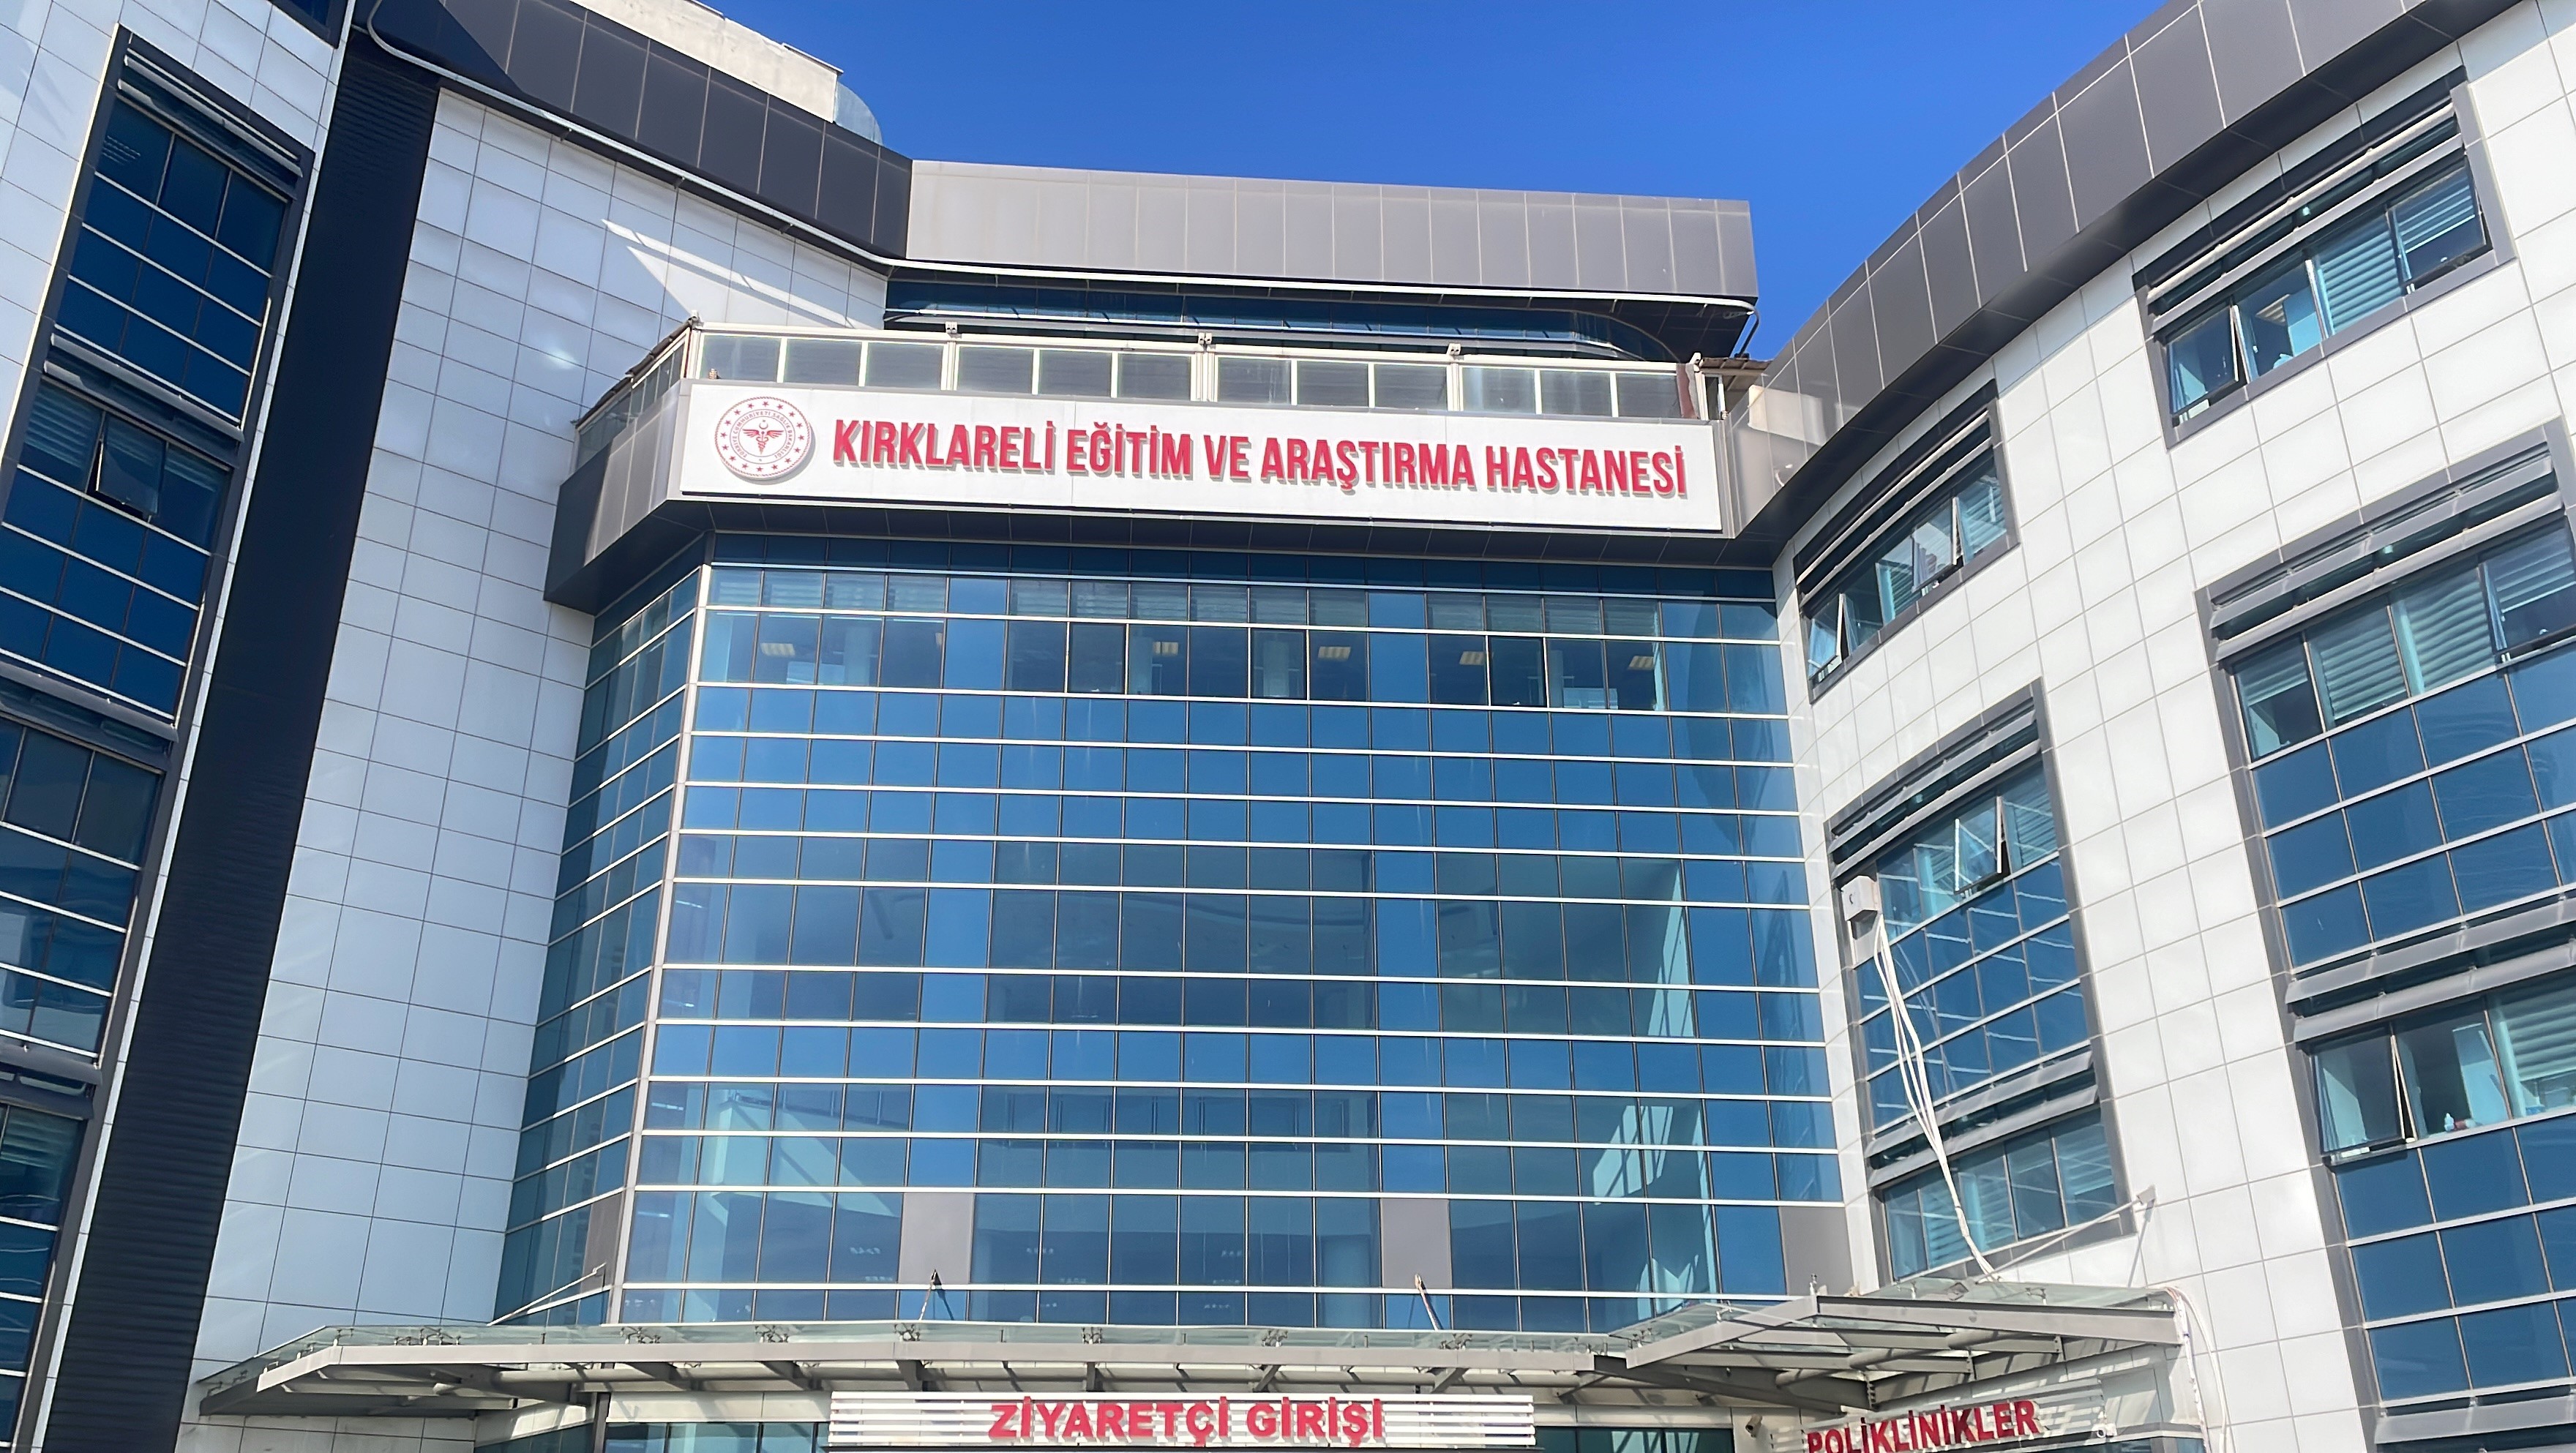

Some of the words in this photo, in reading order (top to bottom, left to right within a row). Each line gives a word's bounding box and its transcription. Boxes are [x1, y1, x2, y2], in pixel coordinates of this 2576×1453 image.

[834, 420, 1054, 470] KIRKLARELİ
[1067, 422, 1191, 476] EĞİTİM
[1204, 435, 1248, 478] VE
[1261, 438, 1475, 490] ARAŞTIRMA
[1486, 446, 1685, 495] HASTANESİ
[988, 1396, 1228, 1447] ZİYARETÇİ
[1246, 1397, 1383, 1448] GİRİŞİ
[1807, 1400, 2039, 1453] POLİKLİNİKLER
